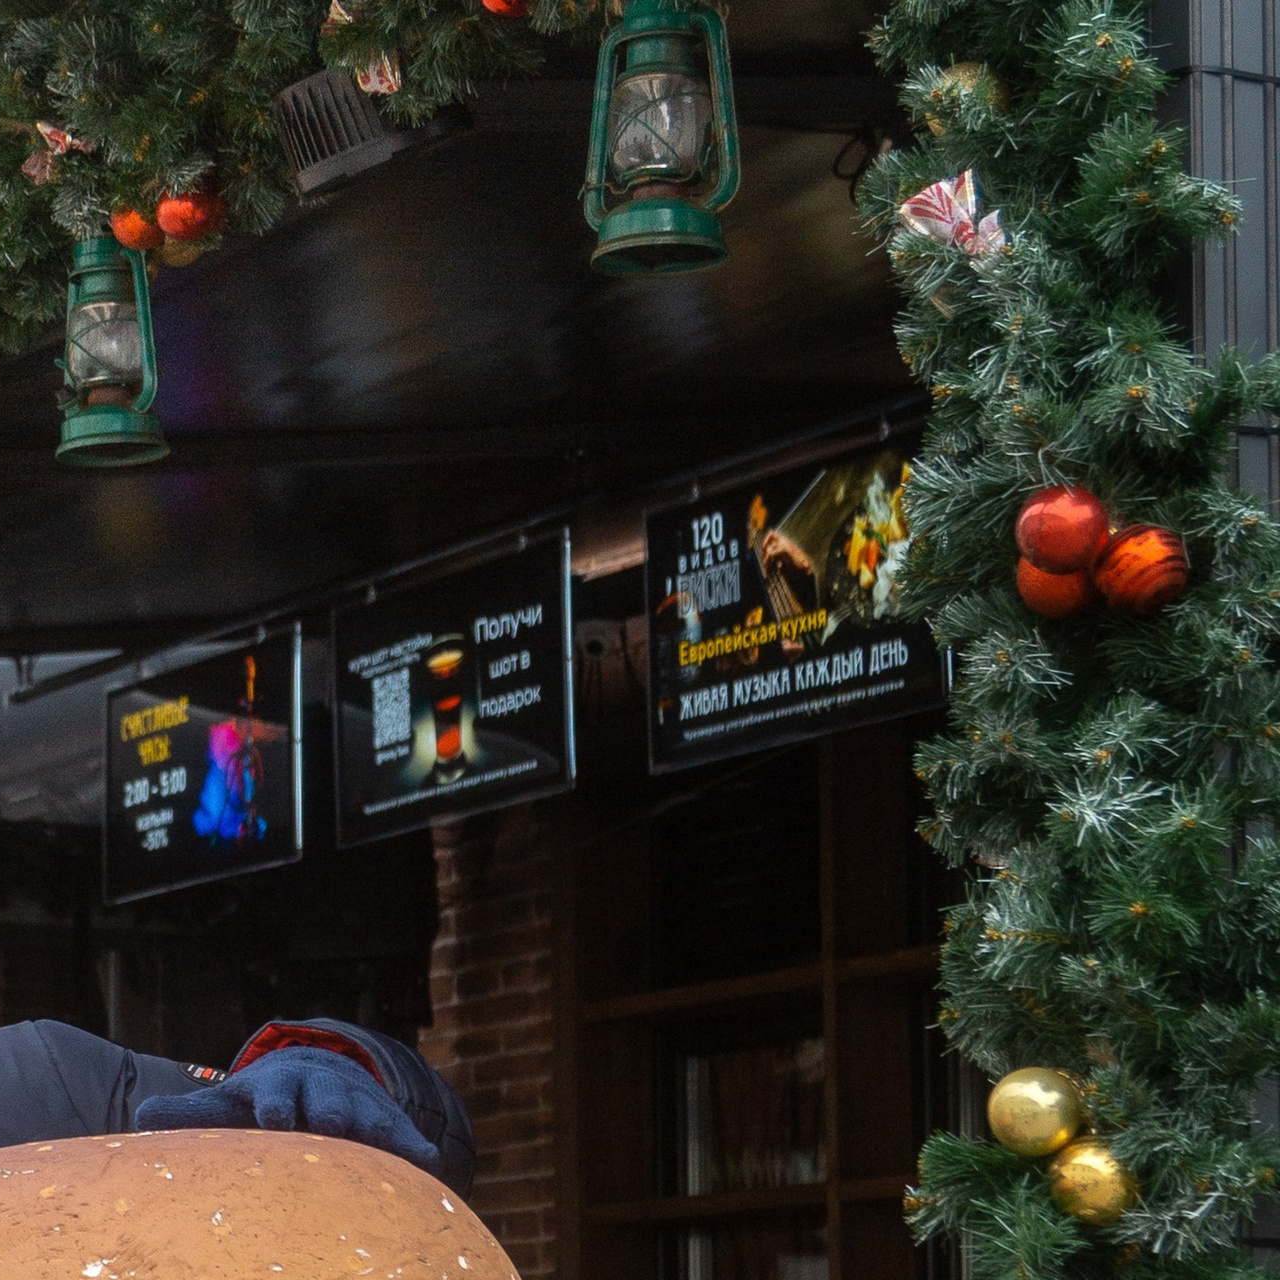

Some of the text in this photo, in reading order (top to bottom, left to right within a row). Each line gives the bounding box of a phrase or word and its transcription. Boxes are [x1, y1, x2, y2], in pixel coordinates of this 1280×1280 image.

[692, 512, 723, 551] 120
[677, 559, 741, 618] ВИСКИ
[474, 604, 543, 644] Получи
[678, 609, 828, 667] Европейская кухня
[489, 656, 517, 679] шот
[679, 638, 909, 722] ЖИВАЯ МУЗЫКА КАЖДЫЙ ДЕНЬ
[481, 685, 542, 719] подарок
